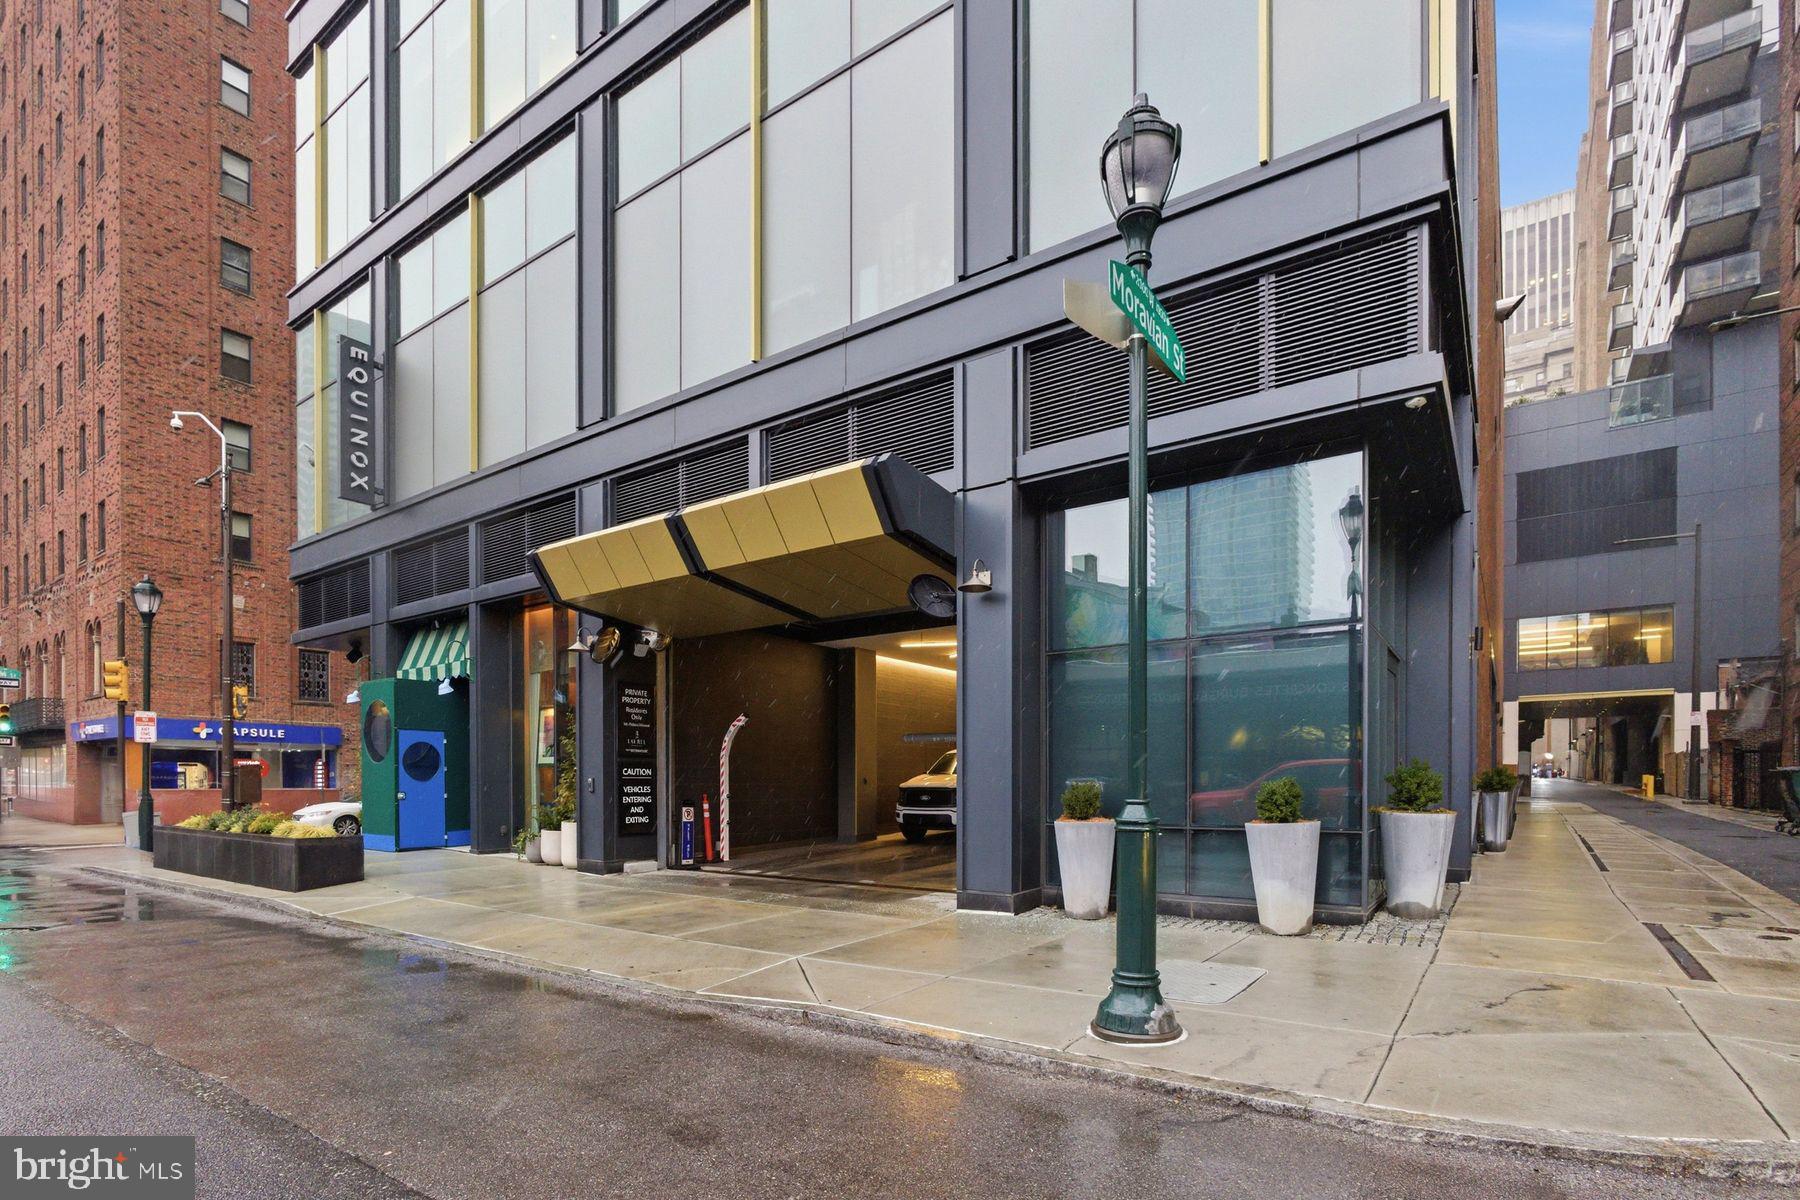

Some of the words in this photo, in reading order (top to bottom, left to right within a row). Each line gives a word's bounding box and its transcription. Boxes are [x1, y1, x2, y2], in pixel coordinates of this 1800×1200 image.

[1112, 263, 1169, 360] Moravian
[1173, 343, 1185, 377] St
[347, 346, 369, 491] EQUINOX
[625, 688, 648, 697] PRIVATE
[621, 696, 651, 705] PROPERTY
[622, 768, 652, 776] CAUTION
[622, 785, 651, 793] VEHICLES
[622, 796, 652, 804] ENTERING
[625, 816, 649, 824] EXITING
